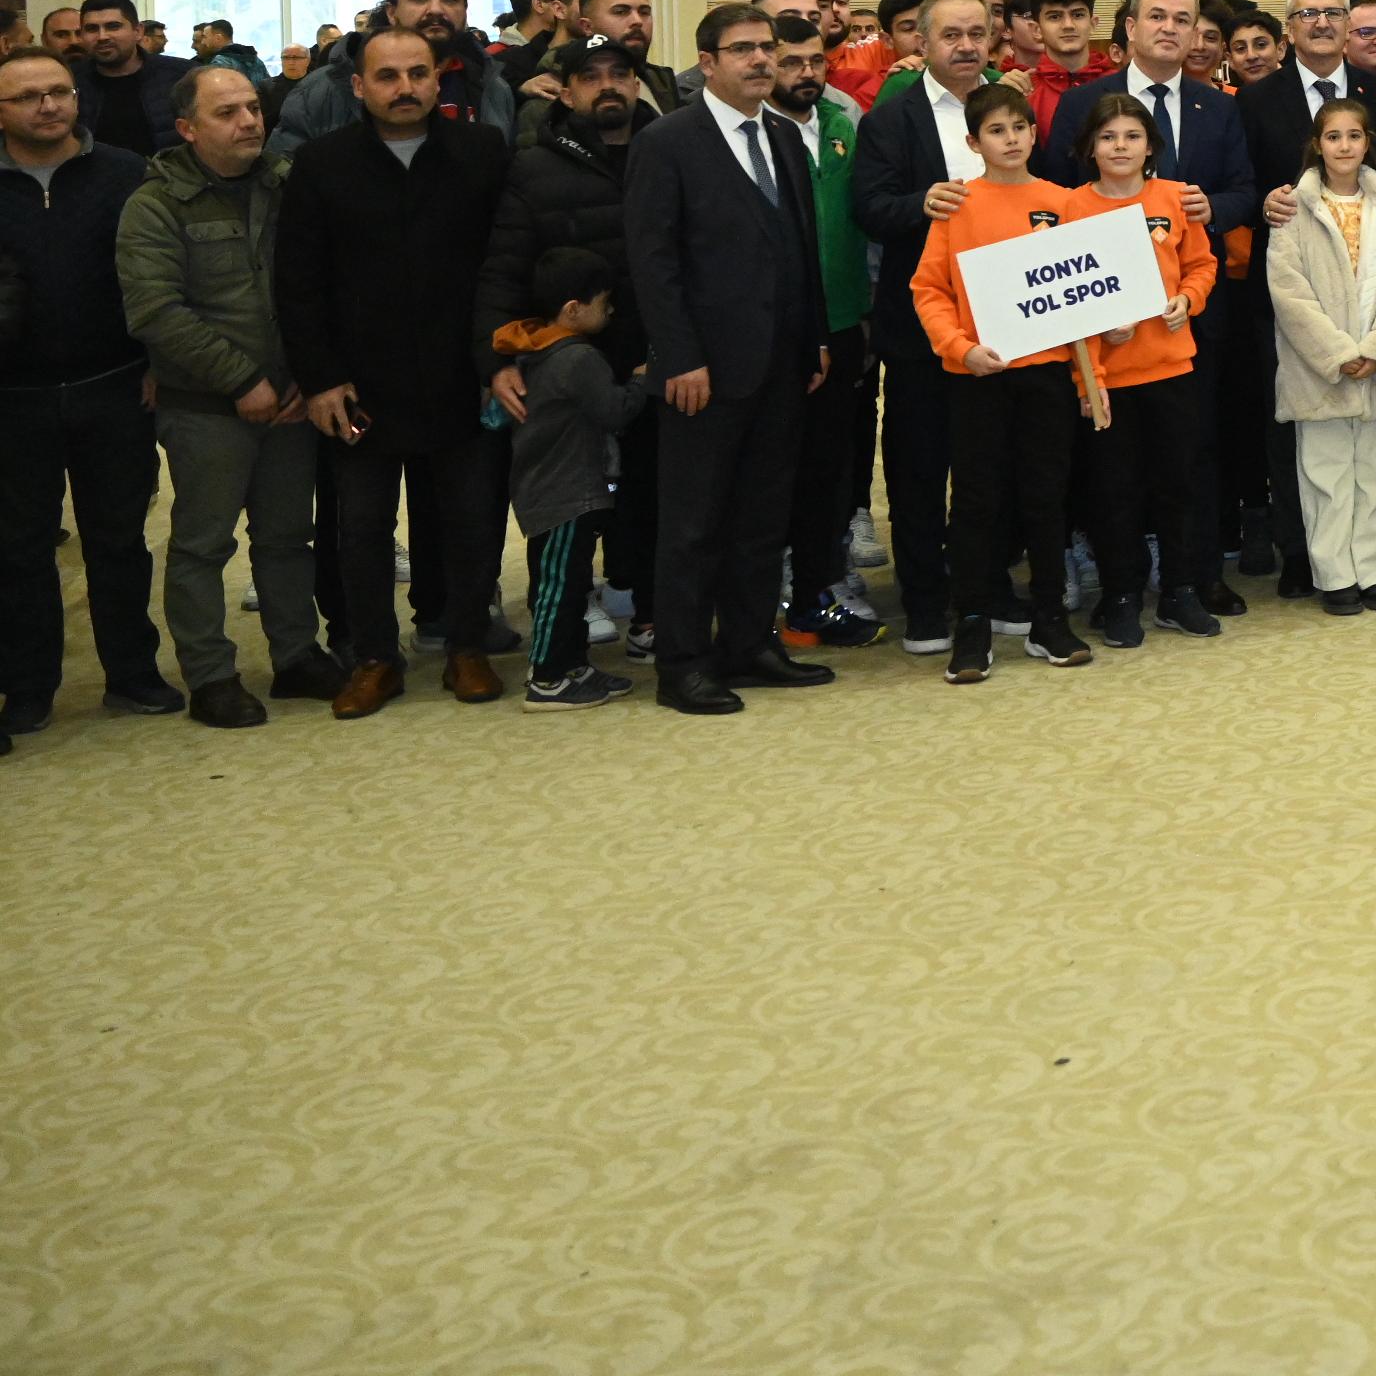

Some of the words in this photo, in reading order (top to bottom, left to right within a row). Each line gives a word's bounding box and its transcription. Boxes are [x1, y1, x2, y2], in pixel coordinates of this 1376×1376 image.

[1024, 253, 1100, 288] KONYA
[1016, 294, 1062, 319] YOL
[1063, 275, 1122, 306] SPOR
